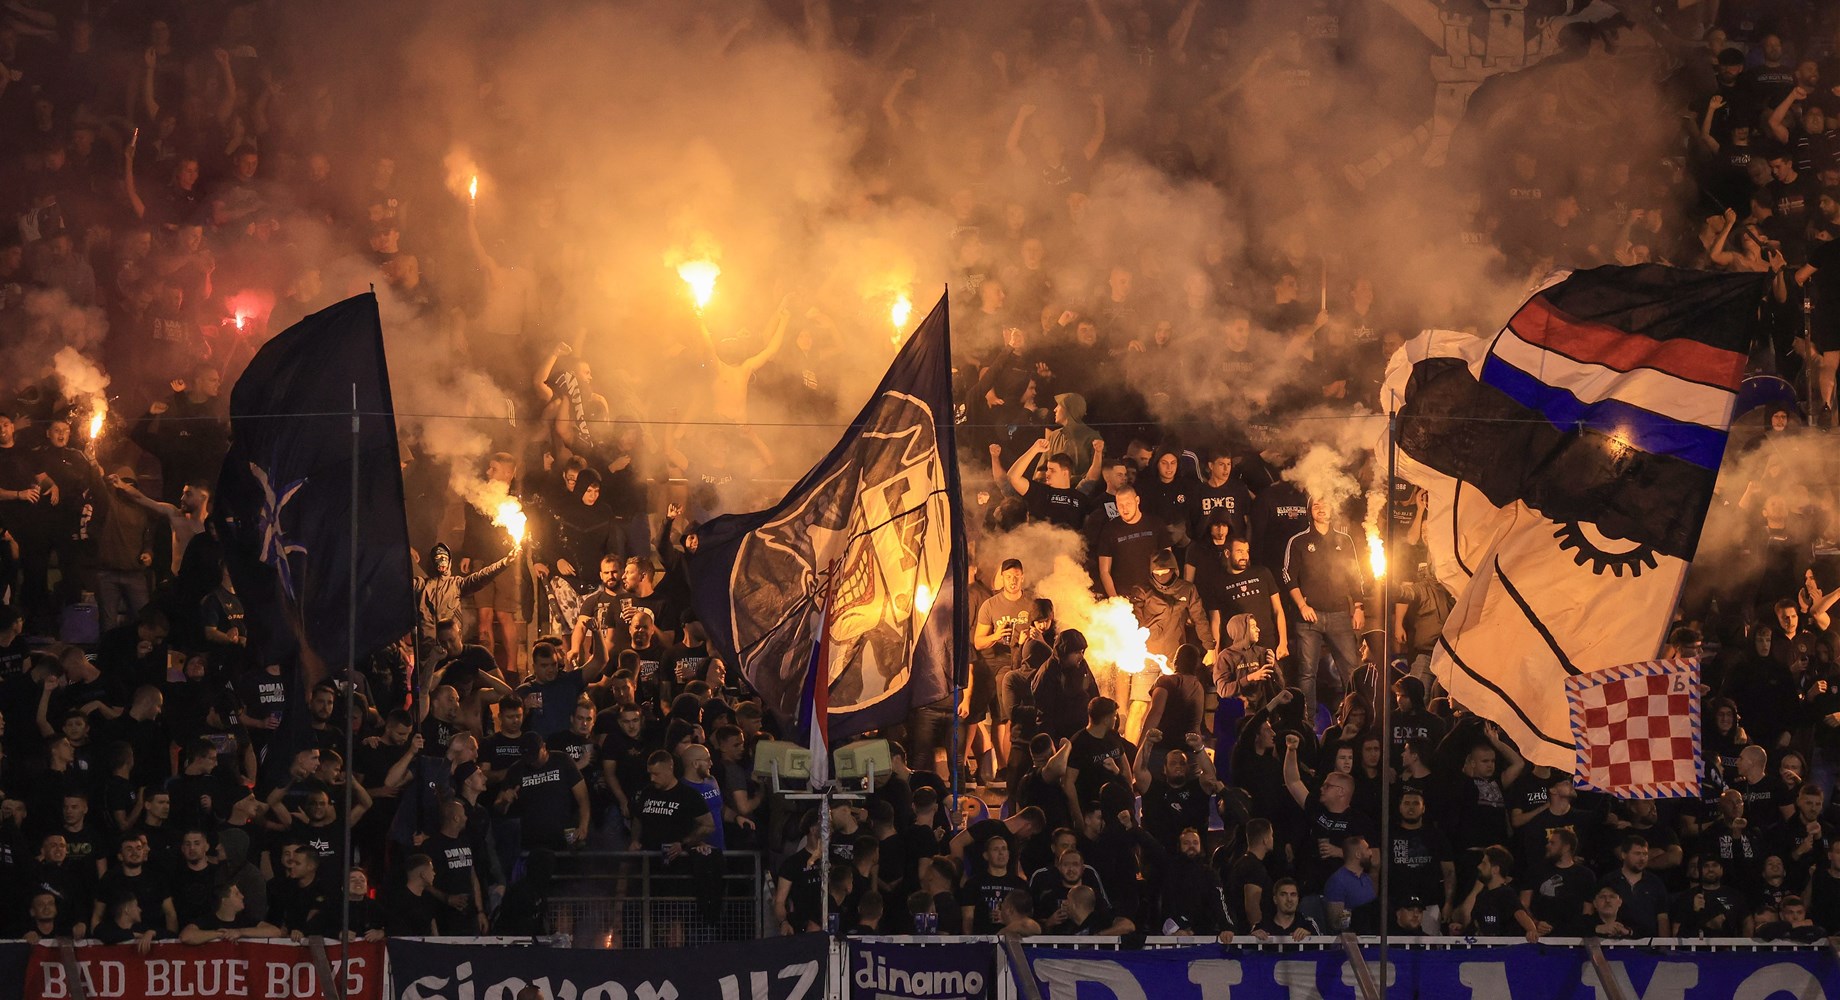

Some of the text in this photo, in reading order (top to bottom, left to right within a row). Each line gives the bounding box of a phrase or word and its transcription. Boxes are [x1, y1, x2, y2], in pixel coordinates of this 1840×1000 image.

[522, 773, 561, 787] ZAGREB
[41, 960, 126, 999] BAD
[145, 959, 249, 998] BLUE
[855, 950, 984, 996] dinamo
